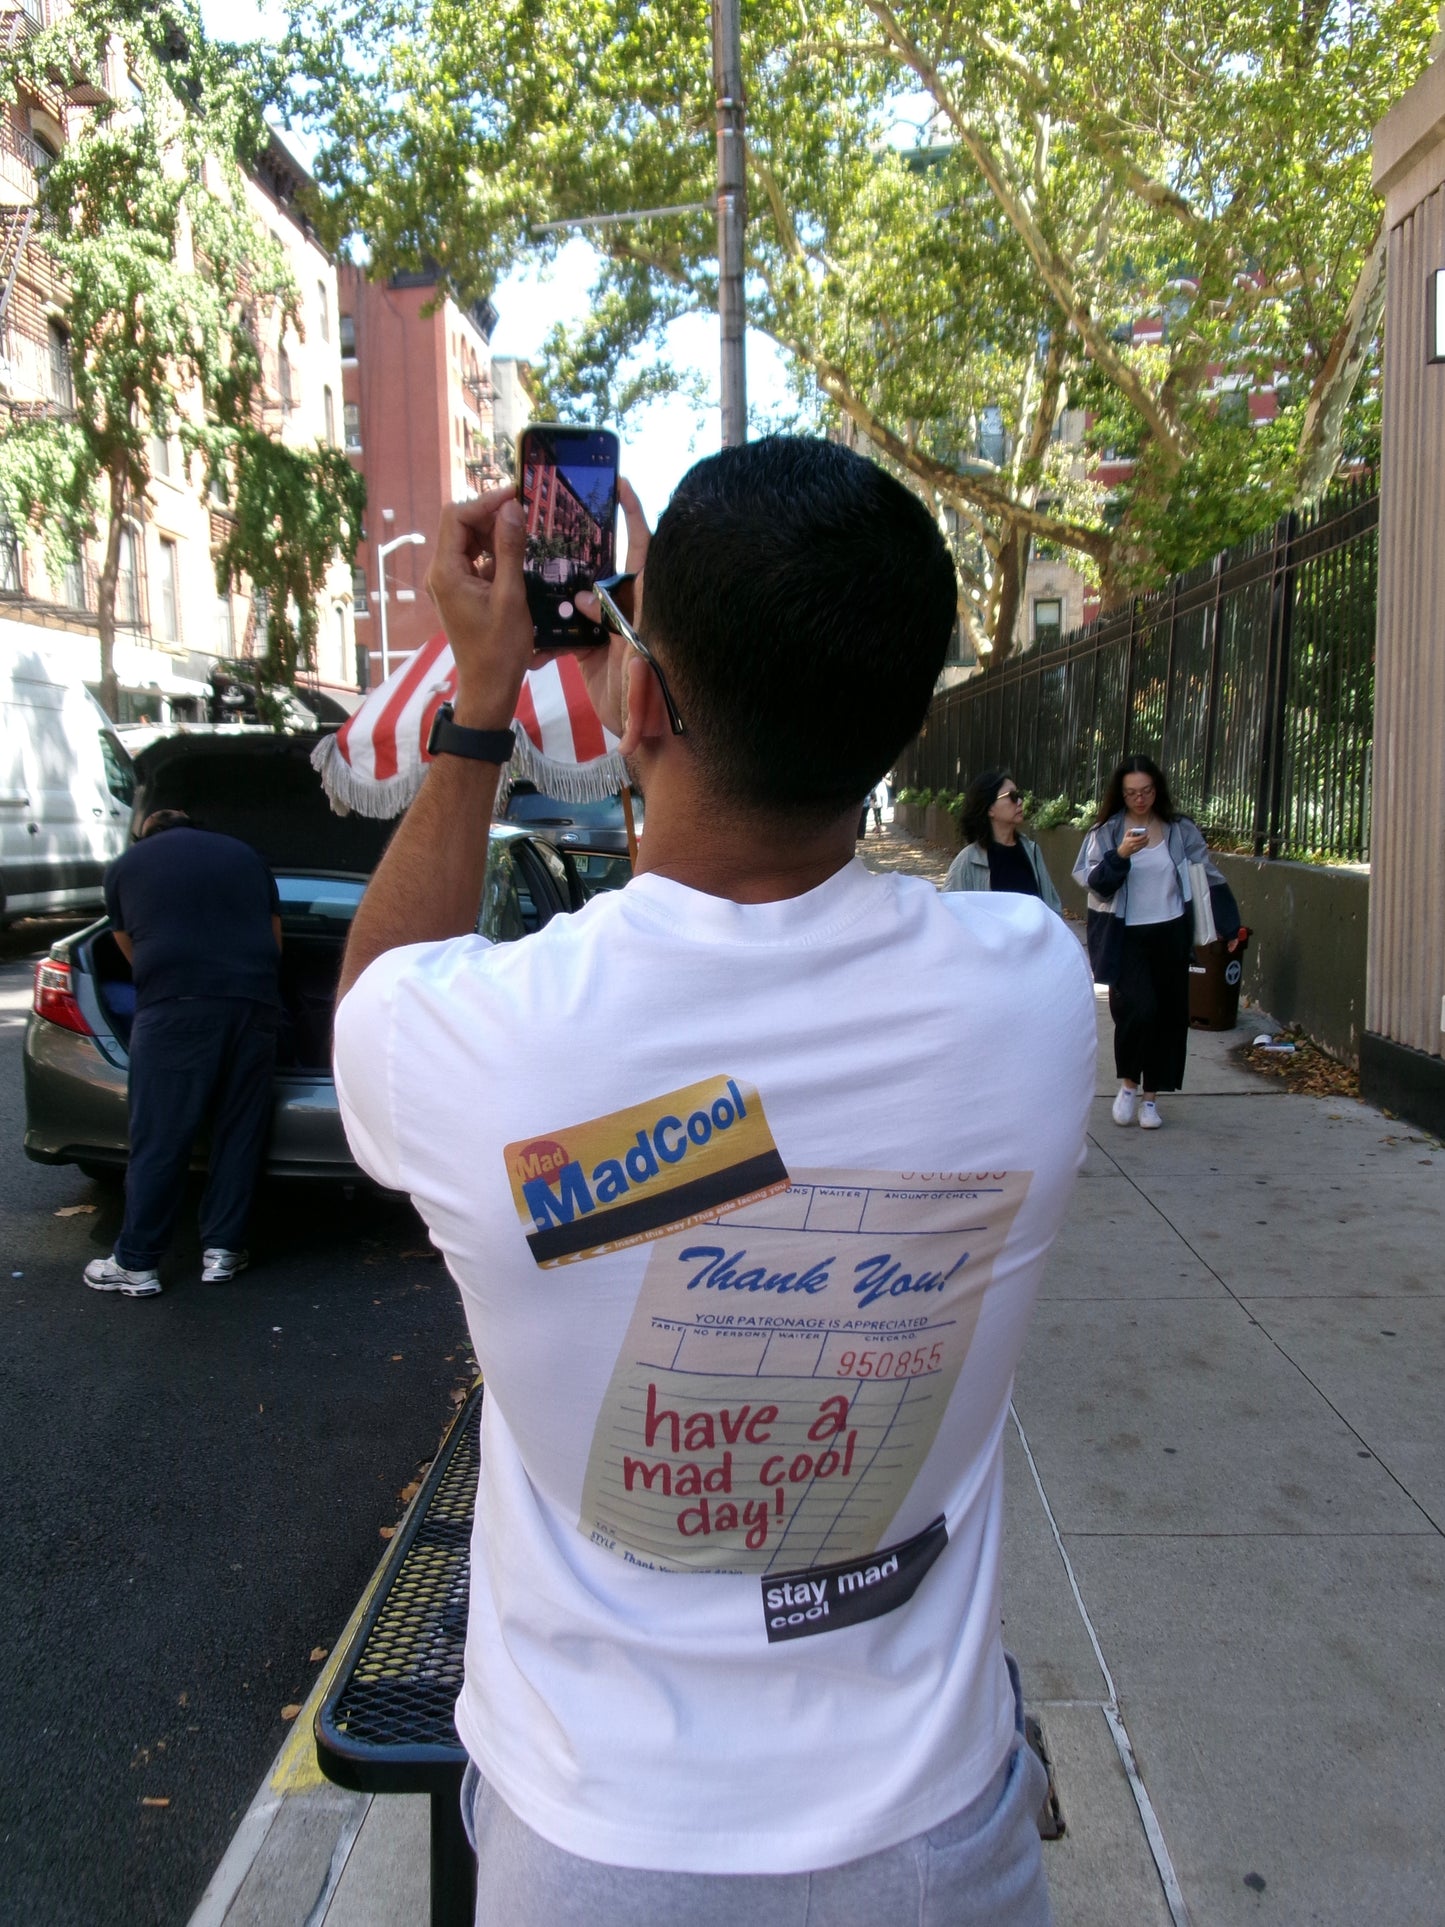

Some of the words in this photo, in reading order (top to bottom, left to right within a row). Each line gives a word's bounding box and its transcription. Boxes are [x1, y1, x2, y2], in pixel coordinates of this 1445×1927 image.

[517, 1148, 563, 1179] Mad
[523, 1079, 747, 1233] MadCool
[819, 1189, 861, 1198] WAITER
[884, 1192, 928, 1200] AMOUNT
[645, 1229, 664, 1240] this
[666, 1222, 685, 1234] way
[693, 1211, 714, 1222] This
[716, 1203, 736, 1215] side
[737, 1190, 767, 1207] facing
[770, 1183, 787, 1196] you
[678, 1246, 836, 1295] Thank
[853, 1252, 970, 1309] You!
[650, 1321, 682, 1332] TABLE
[695, 1314, 736, 1326] YOUR
[737, 1316, 826, 1329] PATRONAGE
[828, 1320, 841, 1328] IS
[843, 1317, 928, 1330] APPRECIATED
[715, 1330, 767, 1338] PERSONS
[778, 1332, 820, 1340] WAITER
[837, 1342, 944, 1378] 950855
[644, 1383, 778, 1453] have
[807, 1395, 849, 1441] a
[623, 1451, 732, 1497] mad
[759, 1430, 857, 1486] cool
[676, 1488, 784, 1550] day!
[591, 1531, 616, 1549] STYLE
[624, 1550, 655, 1570] Thank
[766, 1576, 827, 1610] stay
[837, 1555, 899, 1596] mad
[769, 1602, 829, 1630] cool
